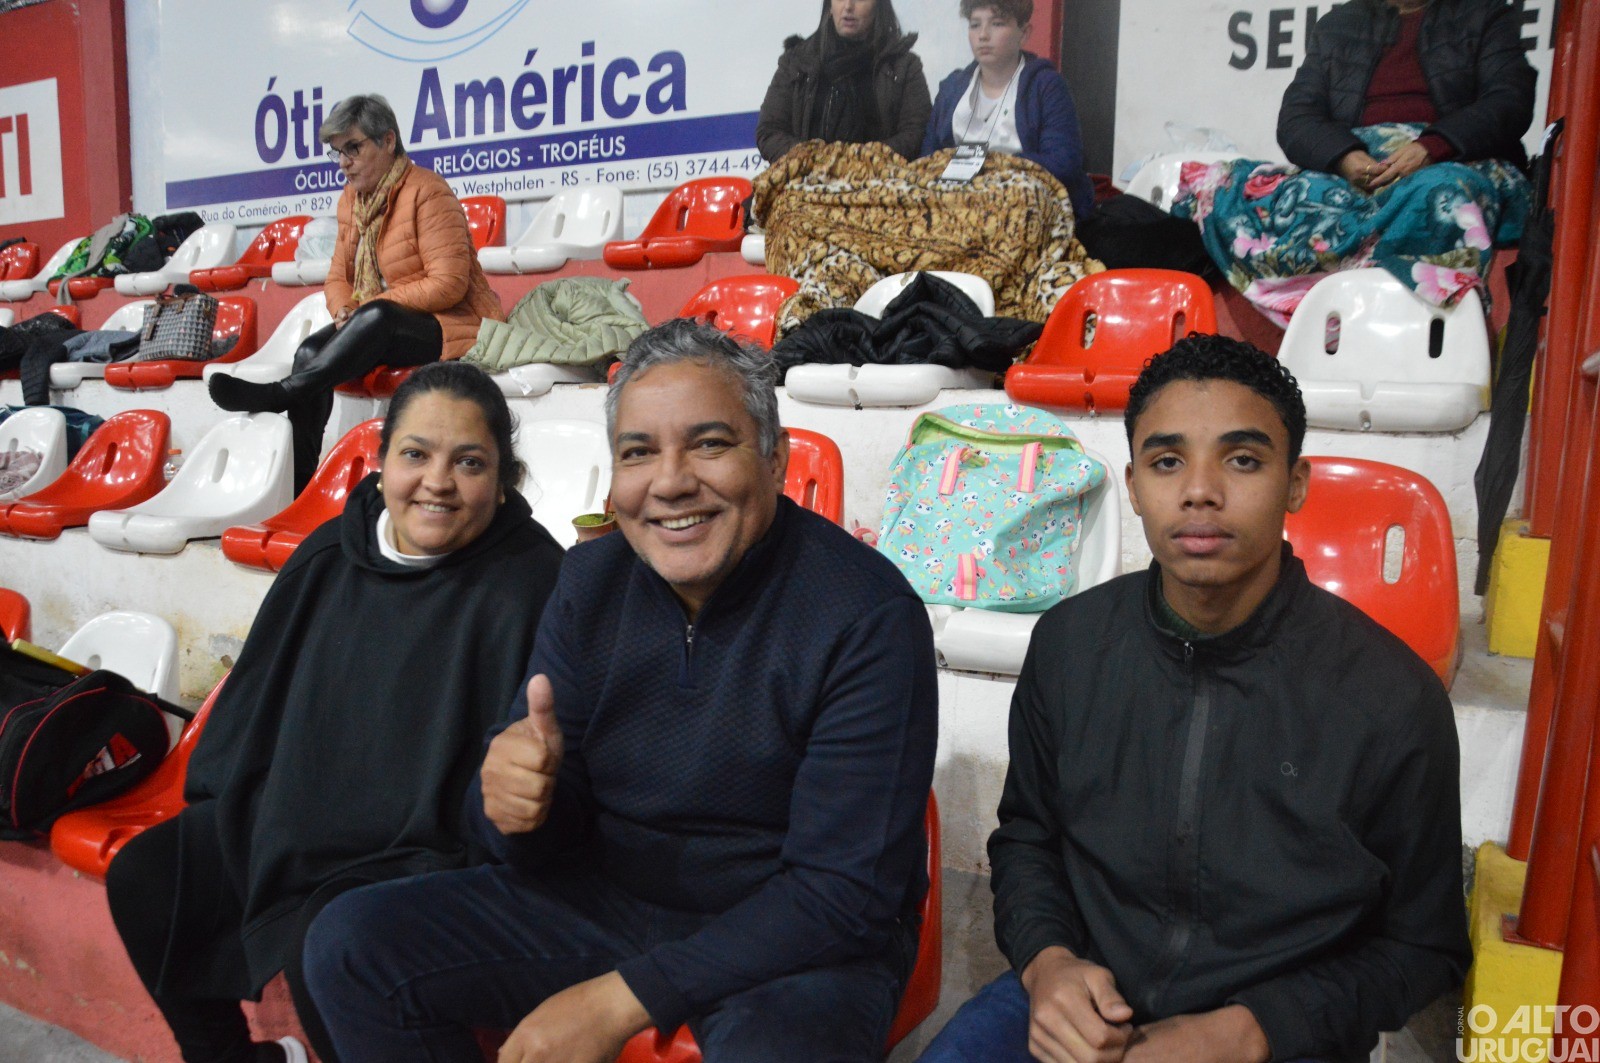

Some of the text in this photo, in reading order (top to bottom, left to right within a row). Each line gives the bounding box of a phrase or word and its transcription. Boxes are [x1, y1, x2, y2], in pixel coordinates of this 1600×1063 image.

[255, 40, 687, 163] Óti América
[295, 169, 348, 190] ÓCULO
[433, 148, 521, 175] RELÓGIOS
[540, 134, 626, 163] TROFÉUS
[463, 175, 544, 196] Westphalen
[561, 170, 579, 186] RS
[596, 168, 640, 183] Fone:
[646, 160, 680, 182] (55)
[685, 153, 767, 176] 3744-49
[201, 209, 219, 222] Rua
[222, 206, 235, 220] do
[238, 201, 291, 219] Comércio,
[311, 196, 333, 211] 829
